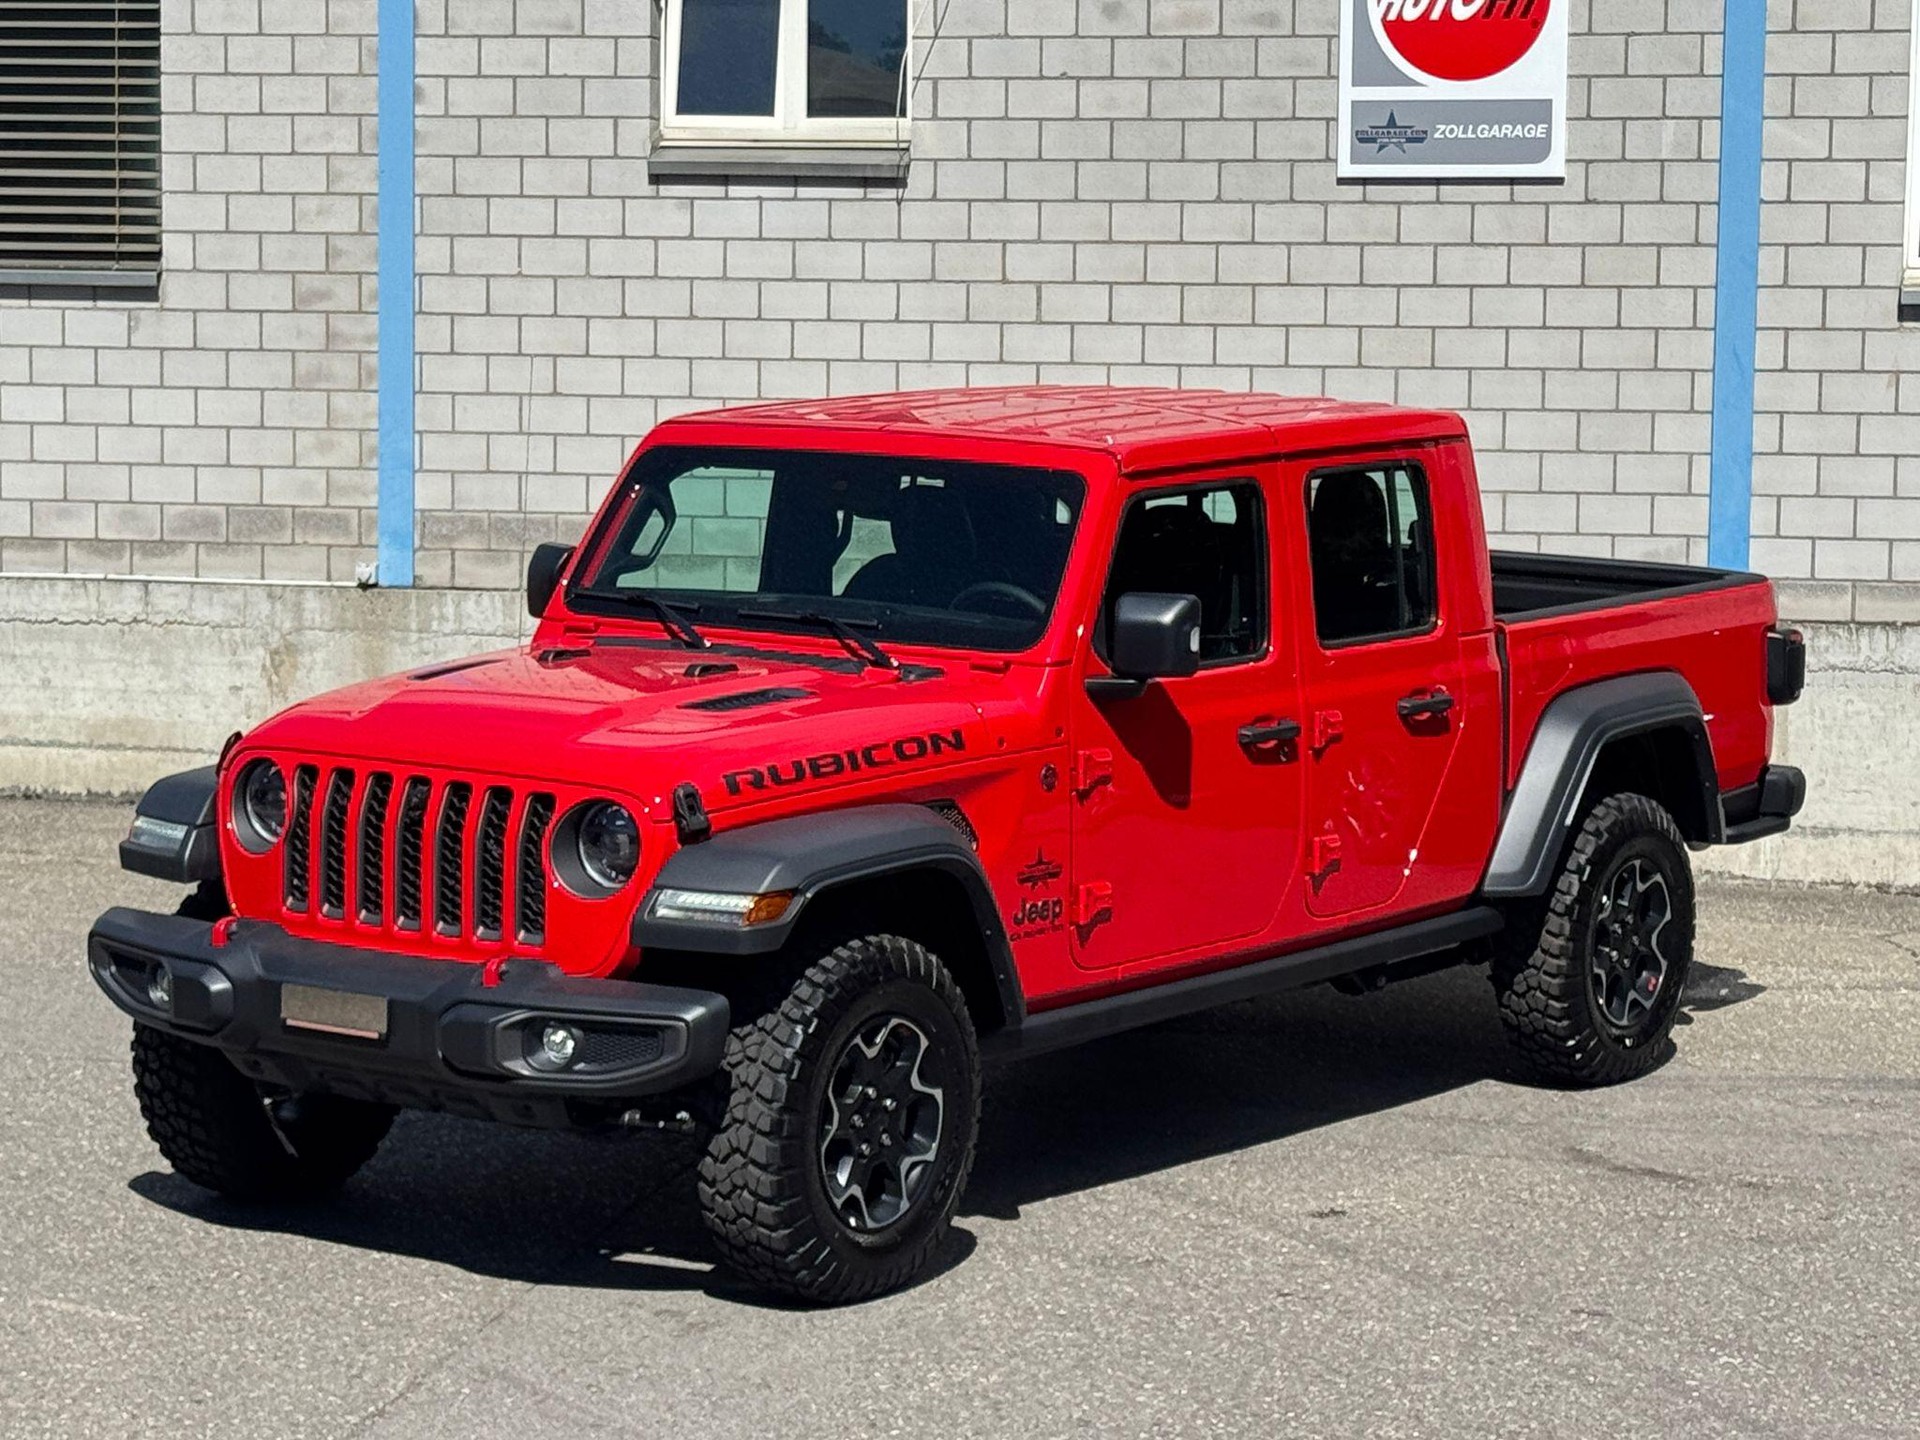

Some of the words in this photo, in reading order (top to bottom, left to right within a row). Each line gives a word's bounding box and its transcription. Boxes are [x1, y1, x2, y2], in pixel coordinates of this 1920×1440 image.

[1433, 124, 1549, 139] ZOLLGARAGE
[722, 729, 966, 796] RUBICON
[1012, 896, 1063, 926] Jeep
